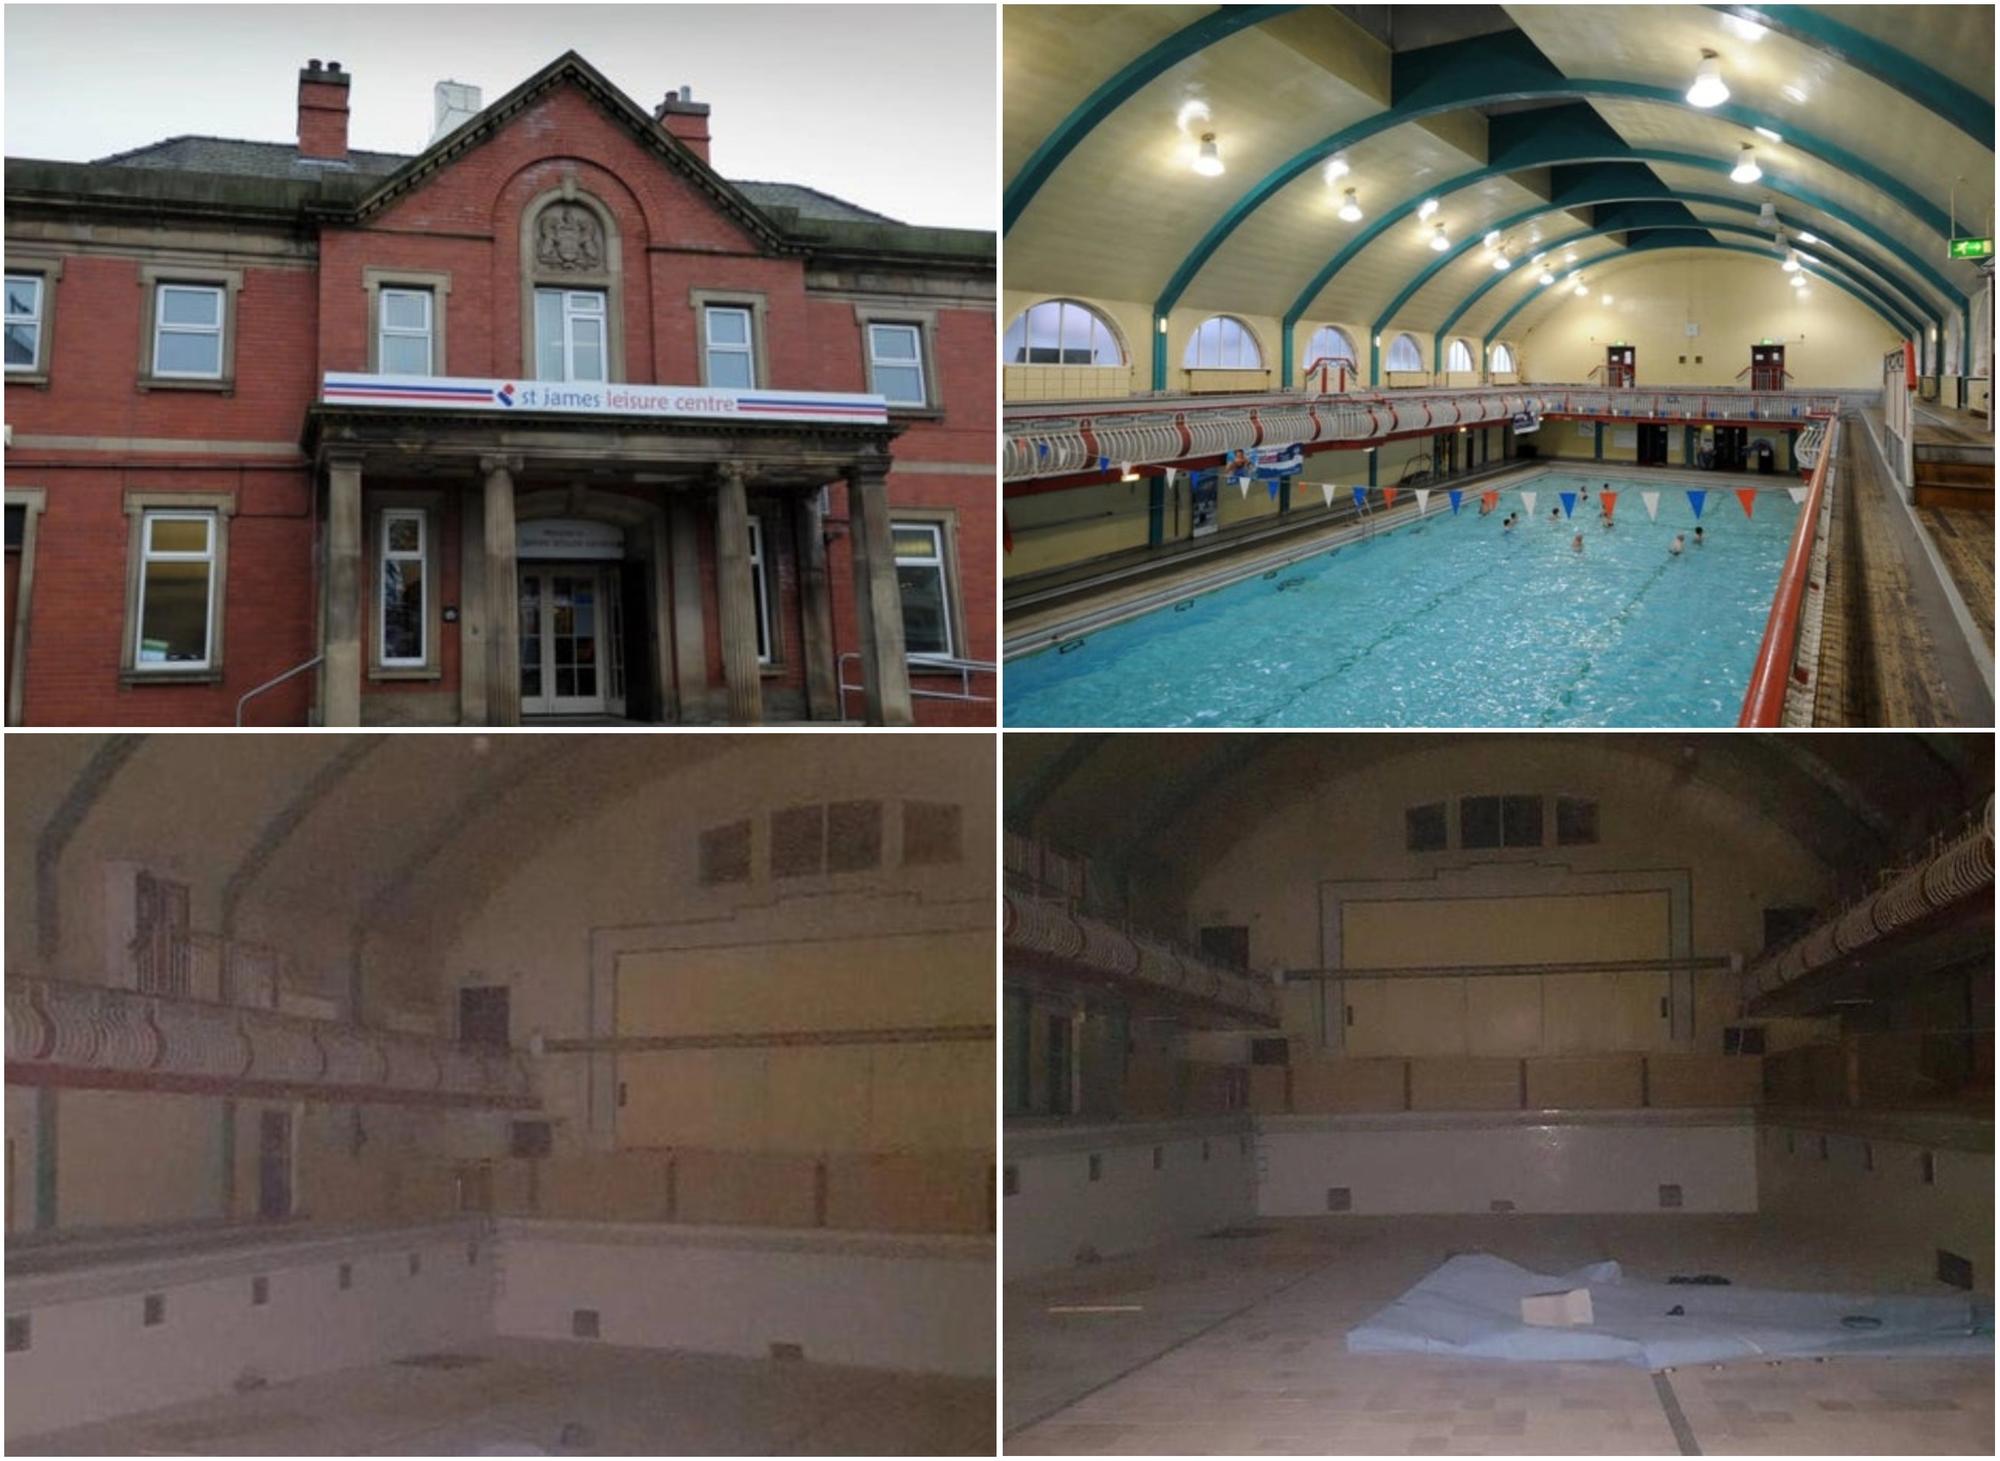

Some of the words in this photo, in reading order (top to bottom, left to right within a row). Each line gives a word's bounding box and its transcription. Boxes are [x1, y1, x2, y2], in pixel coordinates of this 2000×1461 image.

[521, 389, 536, 405] st
[543, 386, 600, 408] james
[606, 388, 669, 411] leisure
[674, 395, 735, 412] centre
